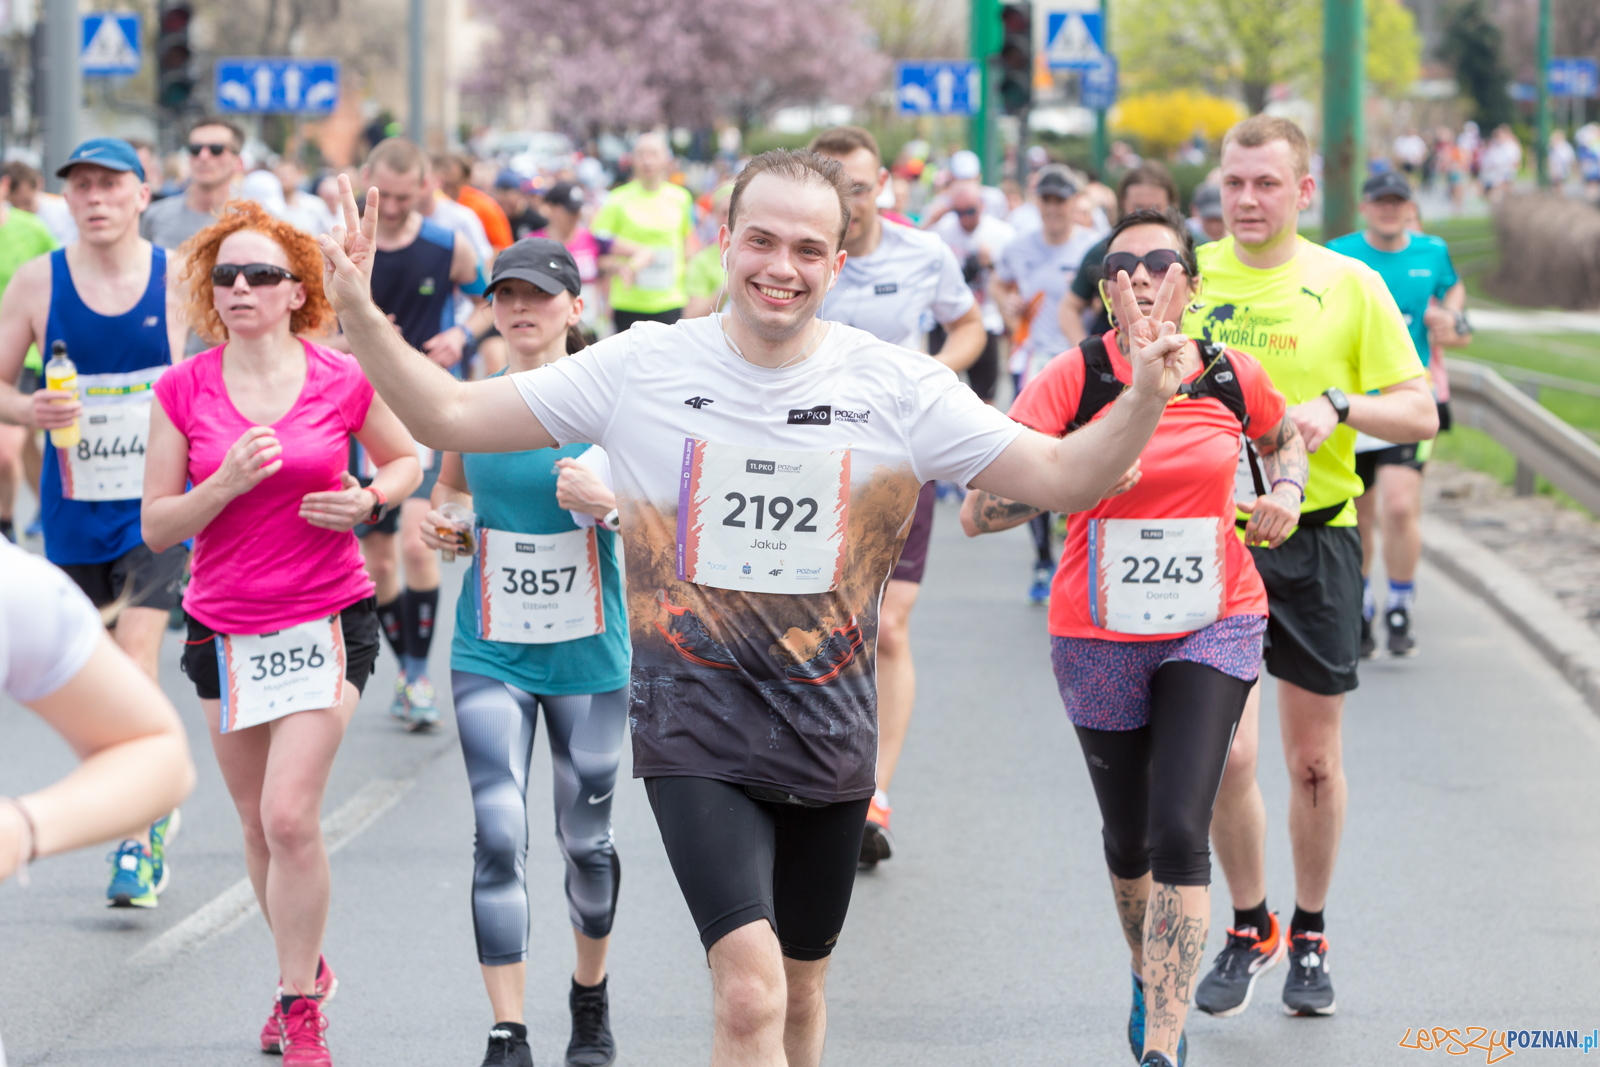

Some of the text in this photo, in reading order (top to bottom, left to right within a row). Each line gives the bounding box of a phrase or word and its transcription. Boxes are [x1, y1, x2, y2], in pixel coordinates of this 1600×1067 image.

[1219, 328, 1298, 350] WORLD RUN
[684, 396, 714, 410] 4F
[806, 410, 828, 420] PKO
[77, 435, 145, 461] 8444
[758, 463, 773, 471] PKO
[722, 491, 819, 533] 2192
[750, 538, 787, 551] Jakub
[502, 565, 577, 595] 3857
[1121, 556, 1204, 584] 2243
[1146, 591, 1179, 600] Dorota
[249, 644, 325, 681] 3856
